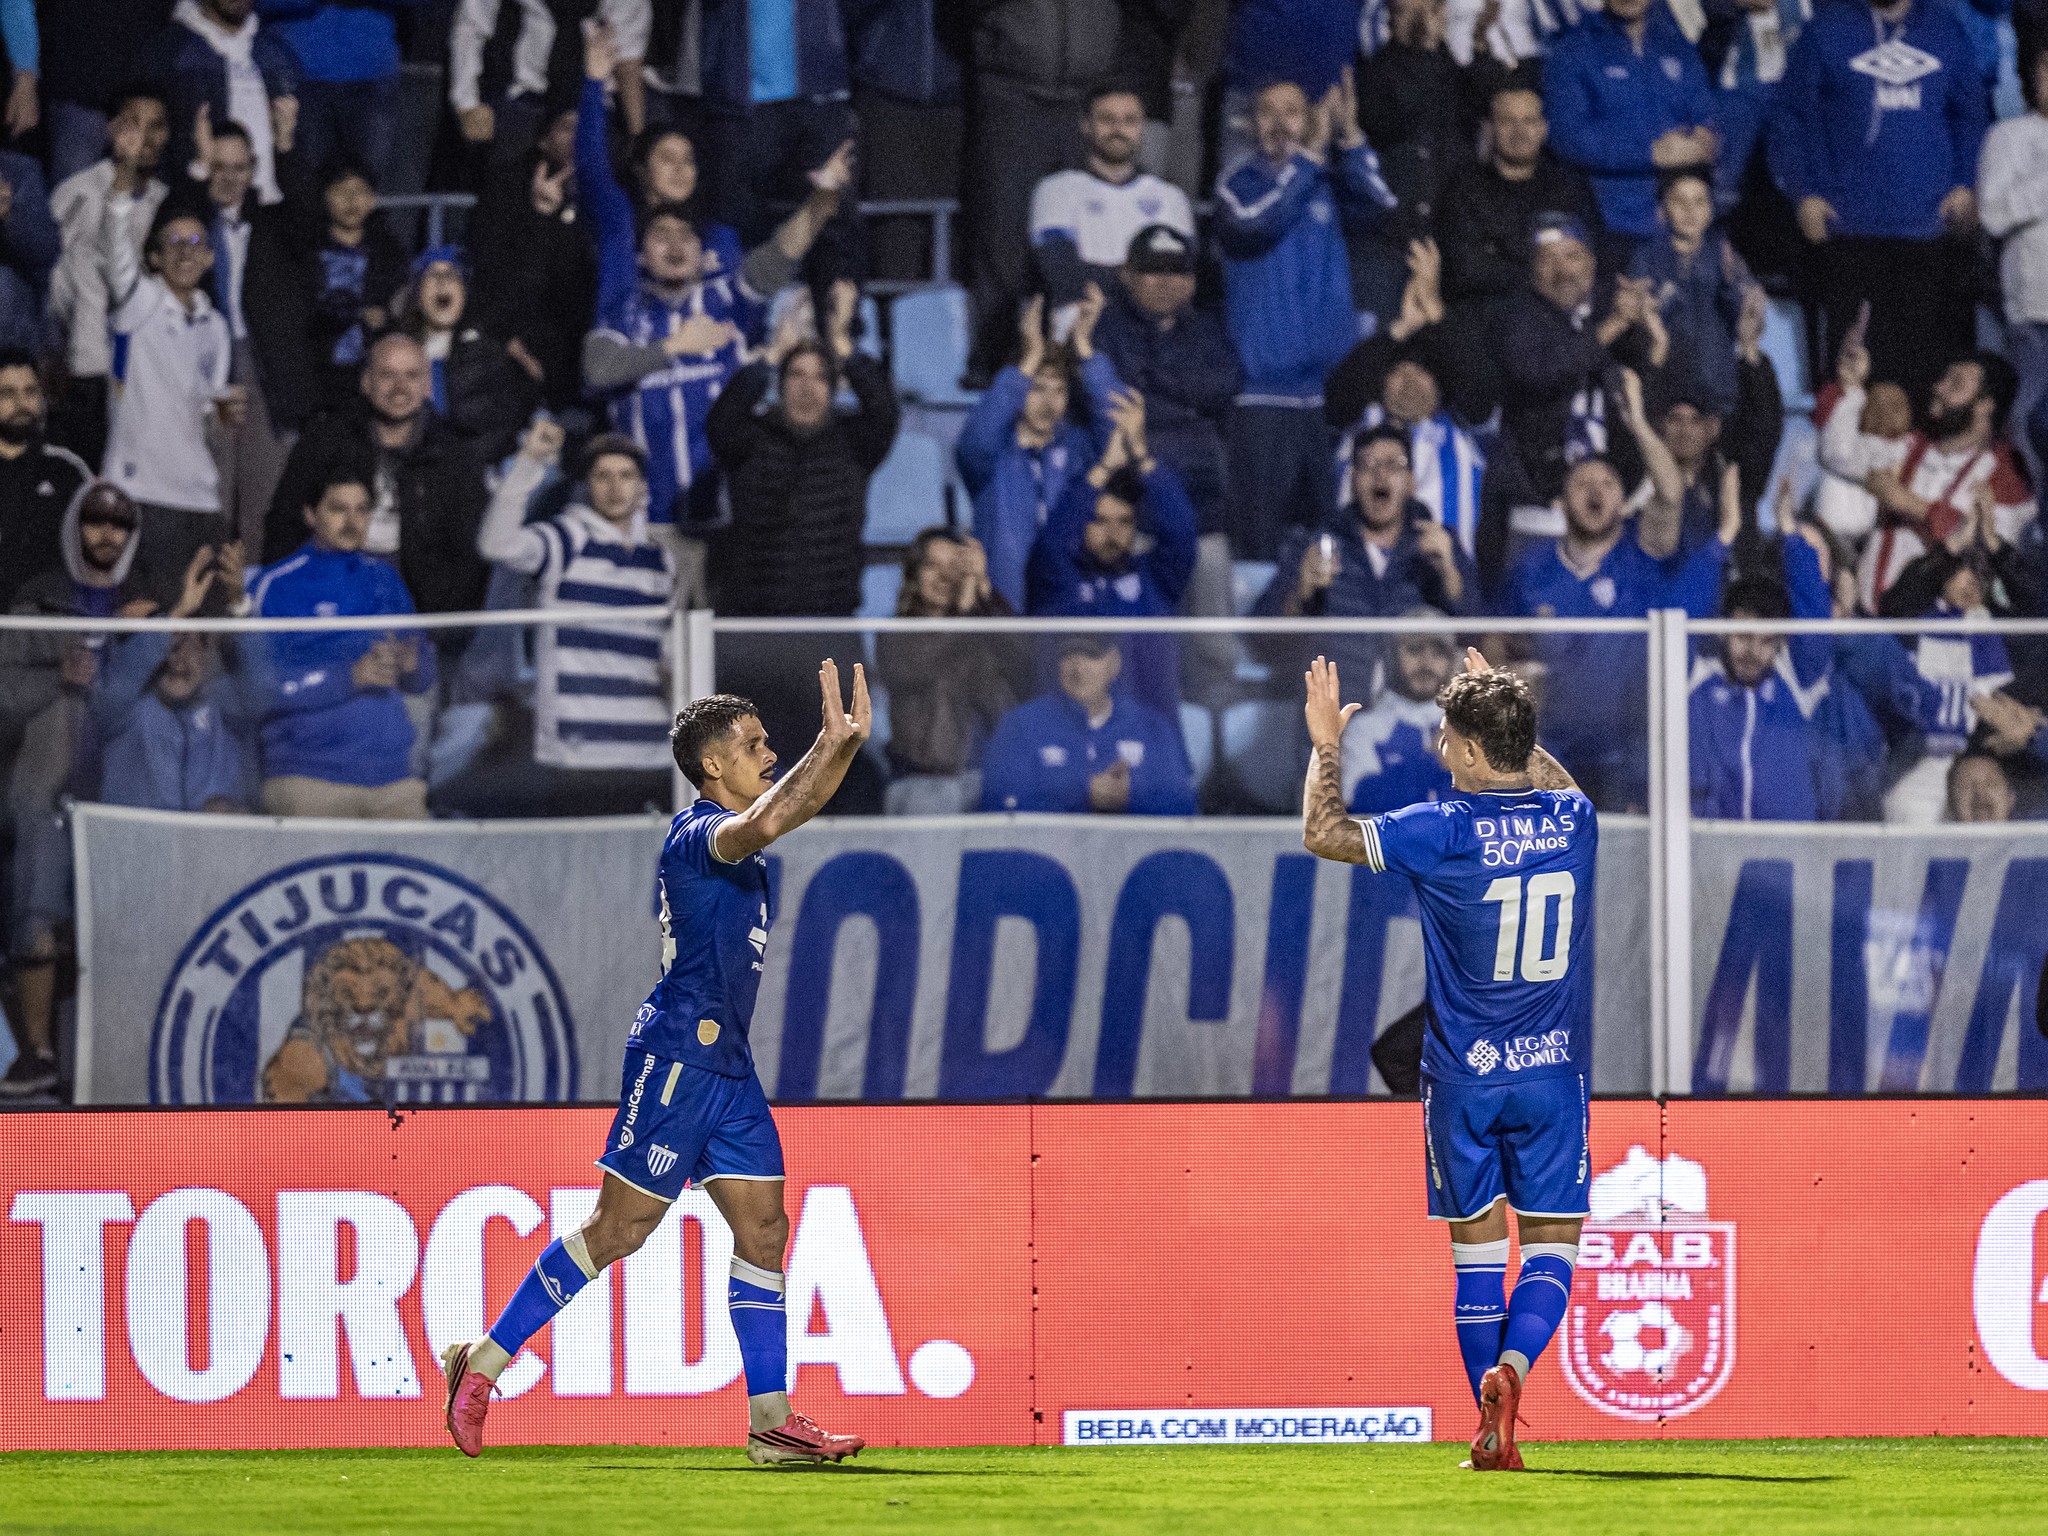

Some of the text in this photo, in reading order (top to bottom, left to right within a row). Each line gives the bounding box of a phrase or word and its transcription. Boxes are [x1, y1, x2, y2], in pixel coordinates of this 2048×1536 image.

[1476, 815, 1575, 838] DIMAS
[1524, 836, 1568, 852] ANOS
[196, 870, 527, 988] TIJUCAS
[1482, 870, 1576, 982] 10
[1505, 1031, 1570, 1053] LEGACY
[1505, 1048, 1571, 1071] COMEX
[1457, 1304, 1500, 1312] VOLT
[1078, 1412, 1422, 1442] BEBA COM MODERAÇÃO
